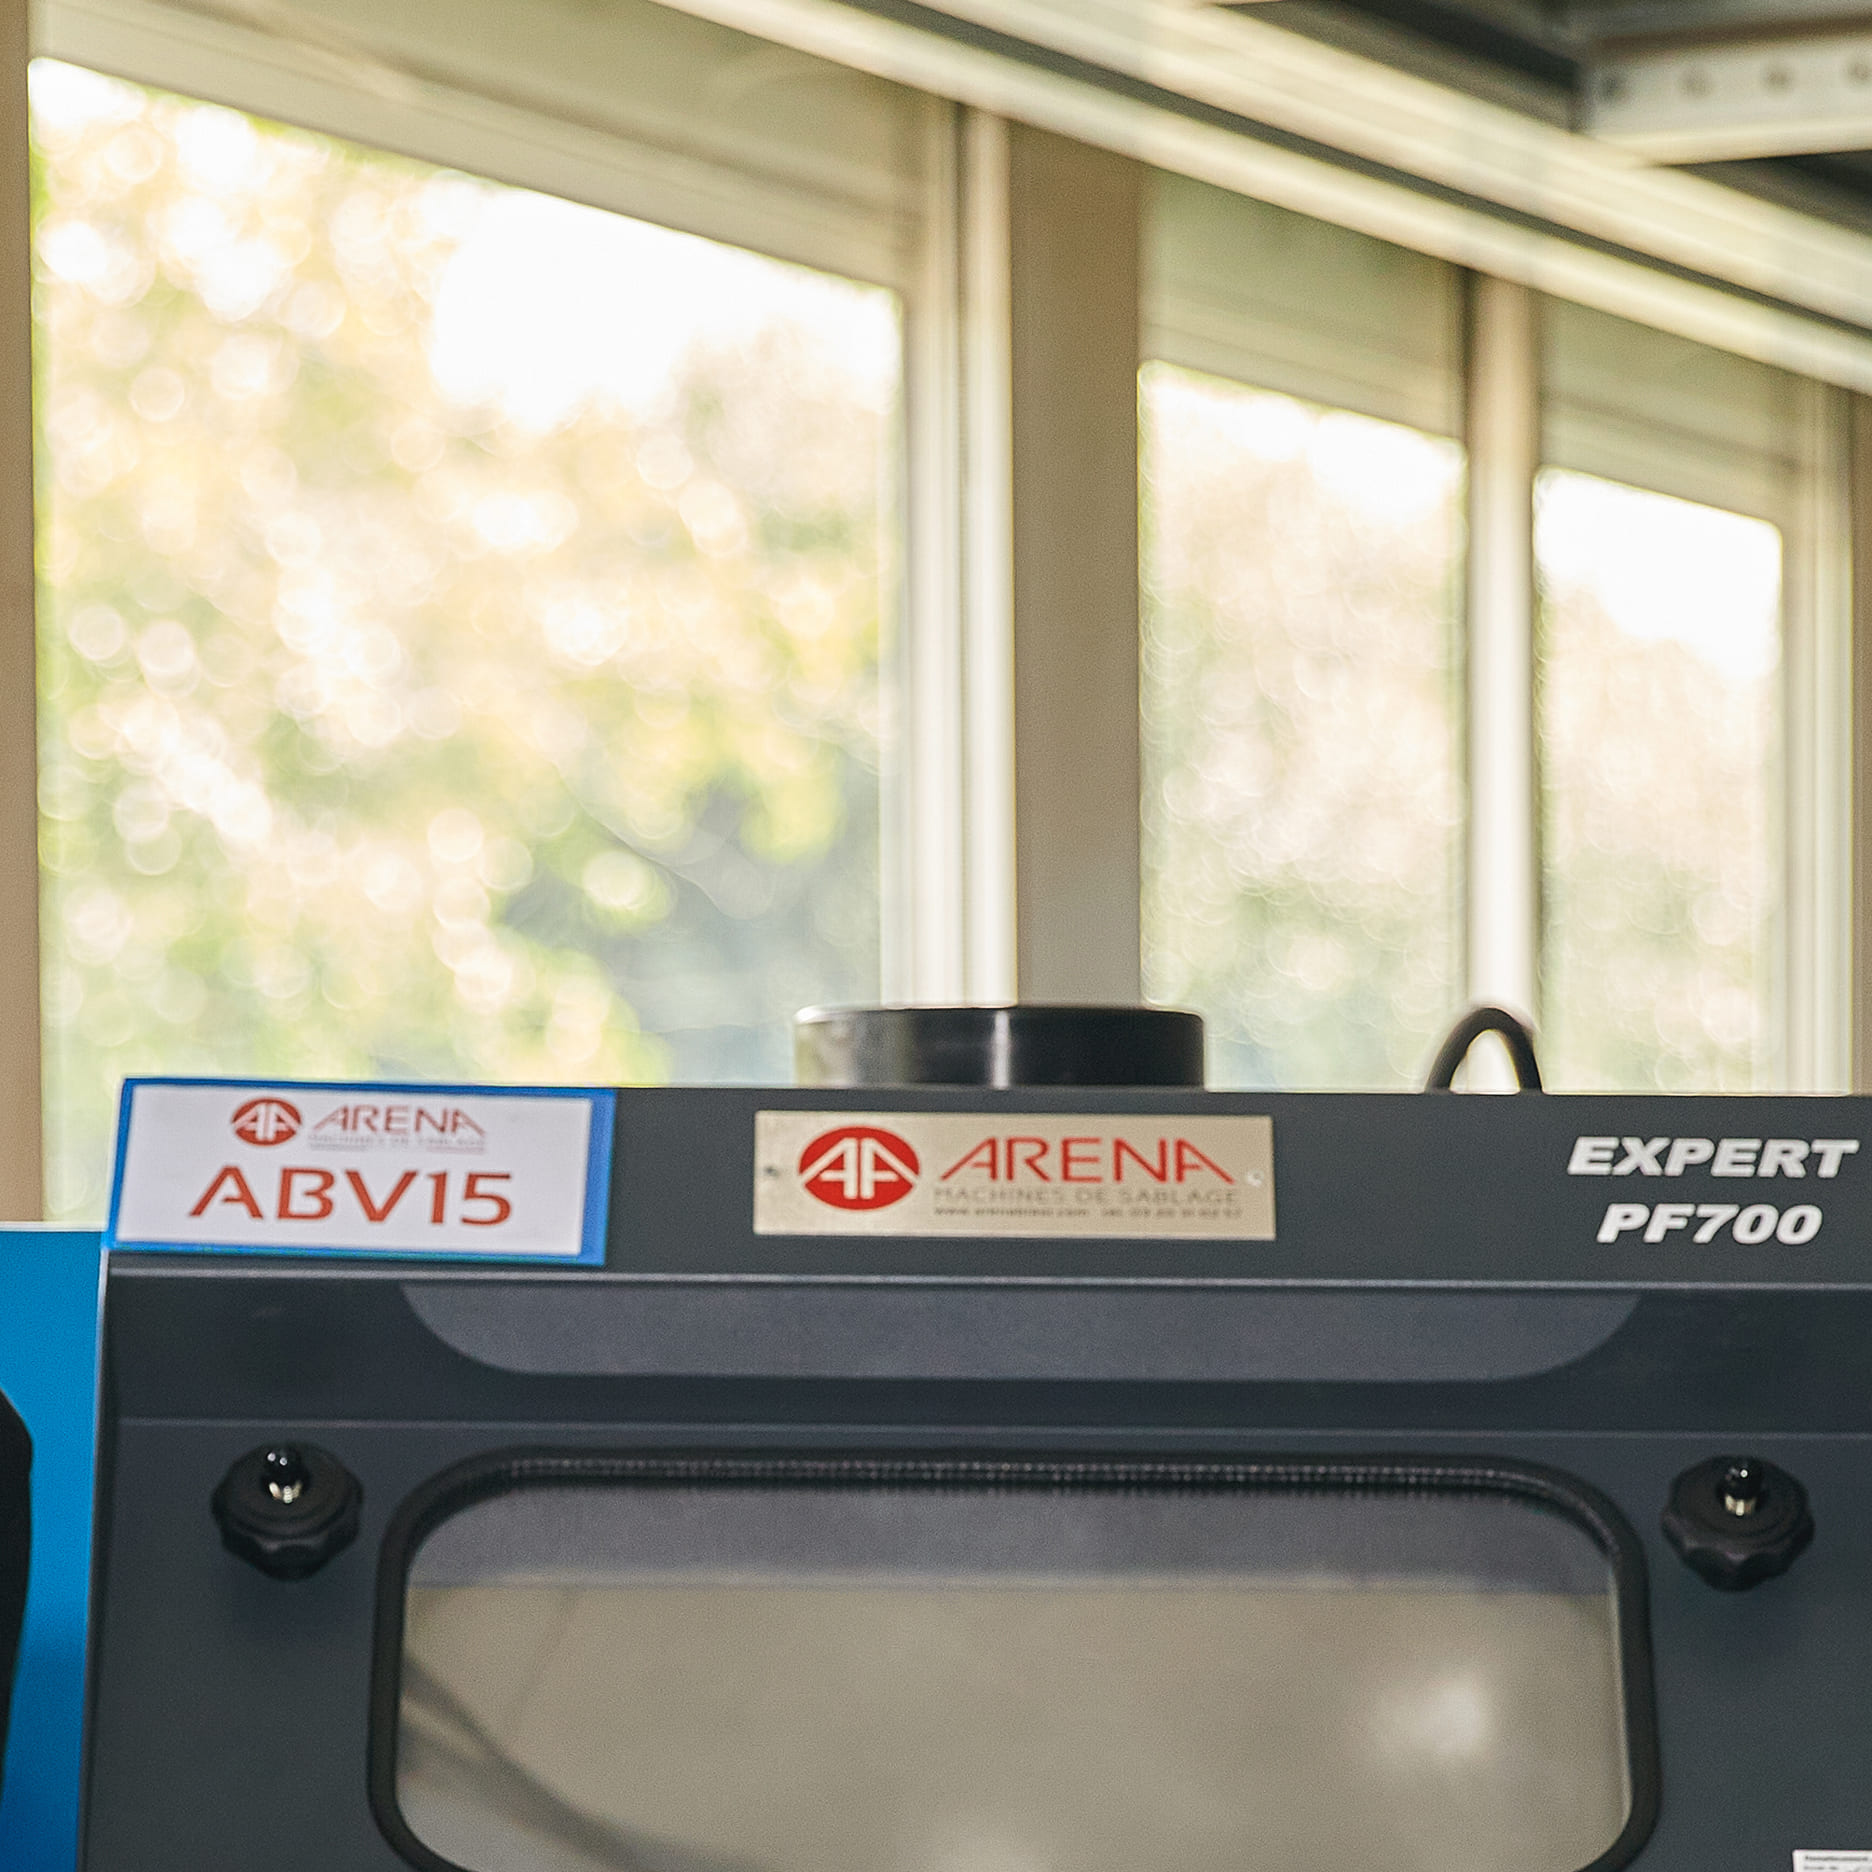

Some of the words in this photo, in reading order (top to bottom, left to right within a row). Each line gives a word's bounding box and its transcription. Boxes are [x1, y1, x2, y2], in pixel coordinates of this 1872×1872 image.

[311, 1104, 488, 1138] ARENA
[940, 1136, 1235, 1184] ARENA
[1567, 1136, 1860, 1178] EXPERT
[188, 1165, 513, 1226] ABV15
[1596, 1203, 1824, 1245] PF700
